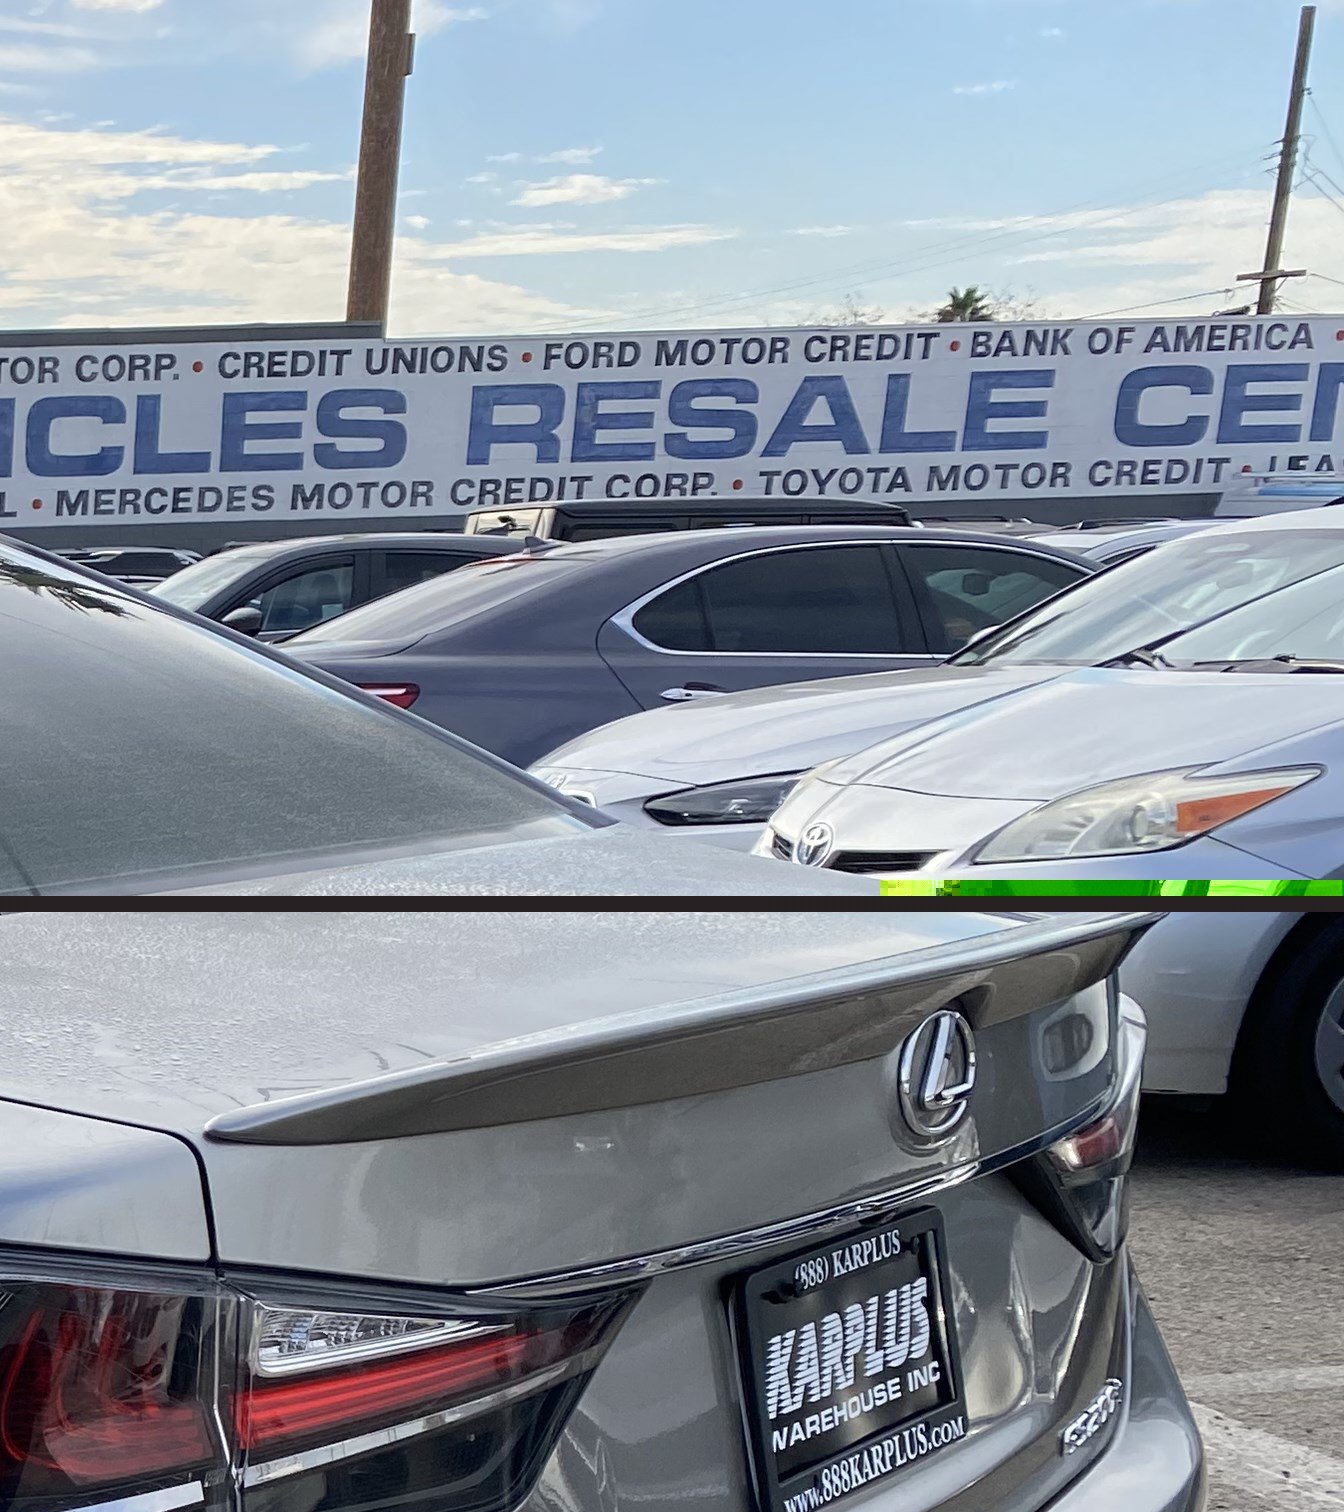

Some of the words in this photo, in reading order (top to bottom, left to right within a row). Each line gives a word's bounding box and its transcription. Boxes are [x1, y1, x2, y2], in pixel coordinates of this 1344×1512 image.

[542, 340, 641, 371] FORD
[654, 336, 791, 367] MOTOR
[803, 332, 941, 362] CREDIT
[970, 328, 1075, 359] BANK
[1087, 326, 1136, 355] OF
[1143, 322, 1314, 354] AMERICA
[74, 352, 180, 383] CORP.
[217, 348, 353, 379] CREDIT
[365, 344, 509, 376] UNIONS
[466, 368, 1056, 466] RESALE
[55, 484, 276, 518] MERCEDES
[289, 479, 435, 512] MOTOR
[450, 474, 593, 507] CREDIT
[605, 471, 718, 499] CORP.
[759, 465, 913, 497] TOYOTA
[925, 461, 1073, 493] MOTOR
[1088, 457, 1232, 488] CREDIT
[794, 1255, 830, 1290] (888)
[832, 1229, 902, 1278] KARPLUS
[765, 1275, 931, 1420] KARPLUS
[907, 1360, 941, 1392] INC
